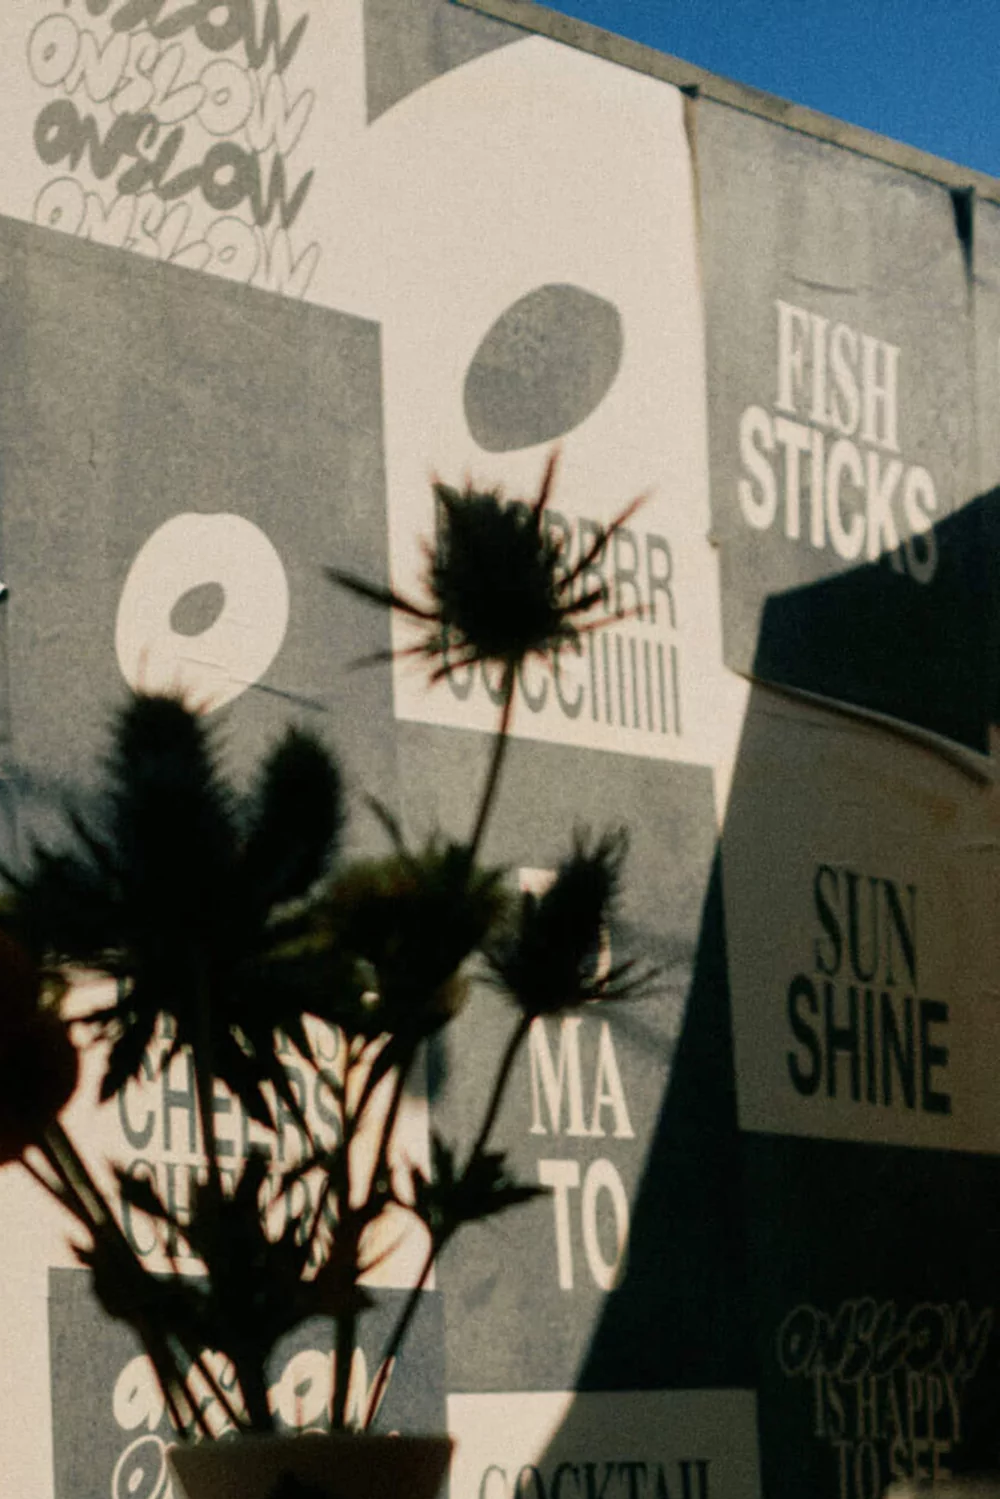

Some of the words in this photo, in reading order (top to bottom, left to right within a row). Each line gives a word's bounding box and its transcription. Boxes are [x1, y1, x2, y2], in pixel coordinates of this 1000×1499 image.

[26, 13, 316, 156] ONSLOW
[33, 98, 316, 230] ONSLOW
[776, 298, 902, 452] FISH
[738, 404, 938, 585] STICKS
[813, 863, 919, 993] SUN
[528, 1016, 635, 1138] MA
[788, 973, 953, 1114] SHINE
[537, 1157, 632, 1292] TO
